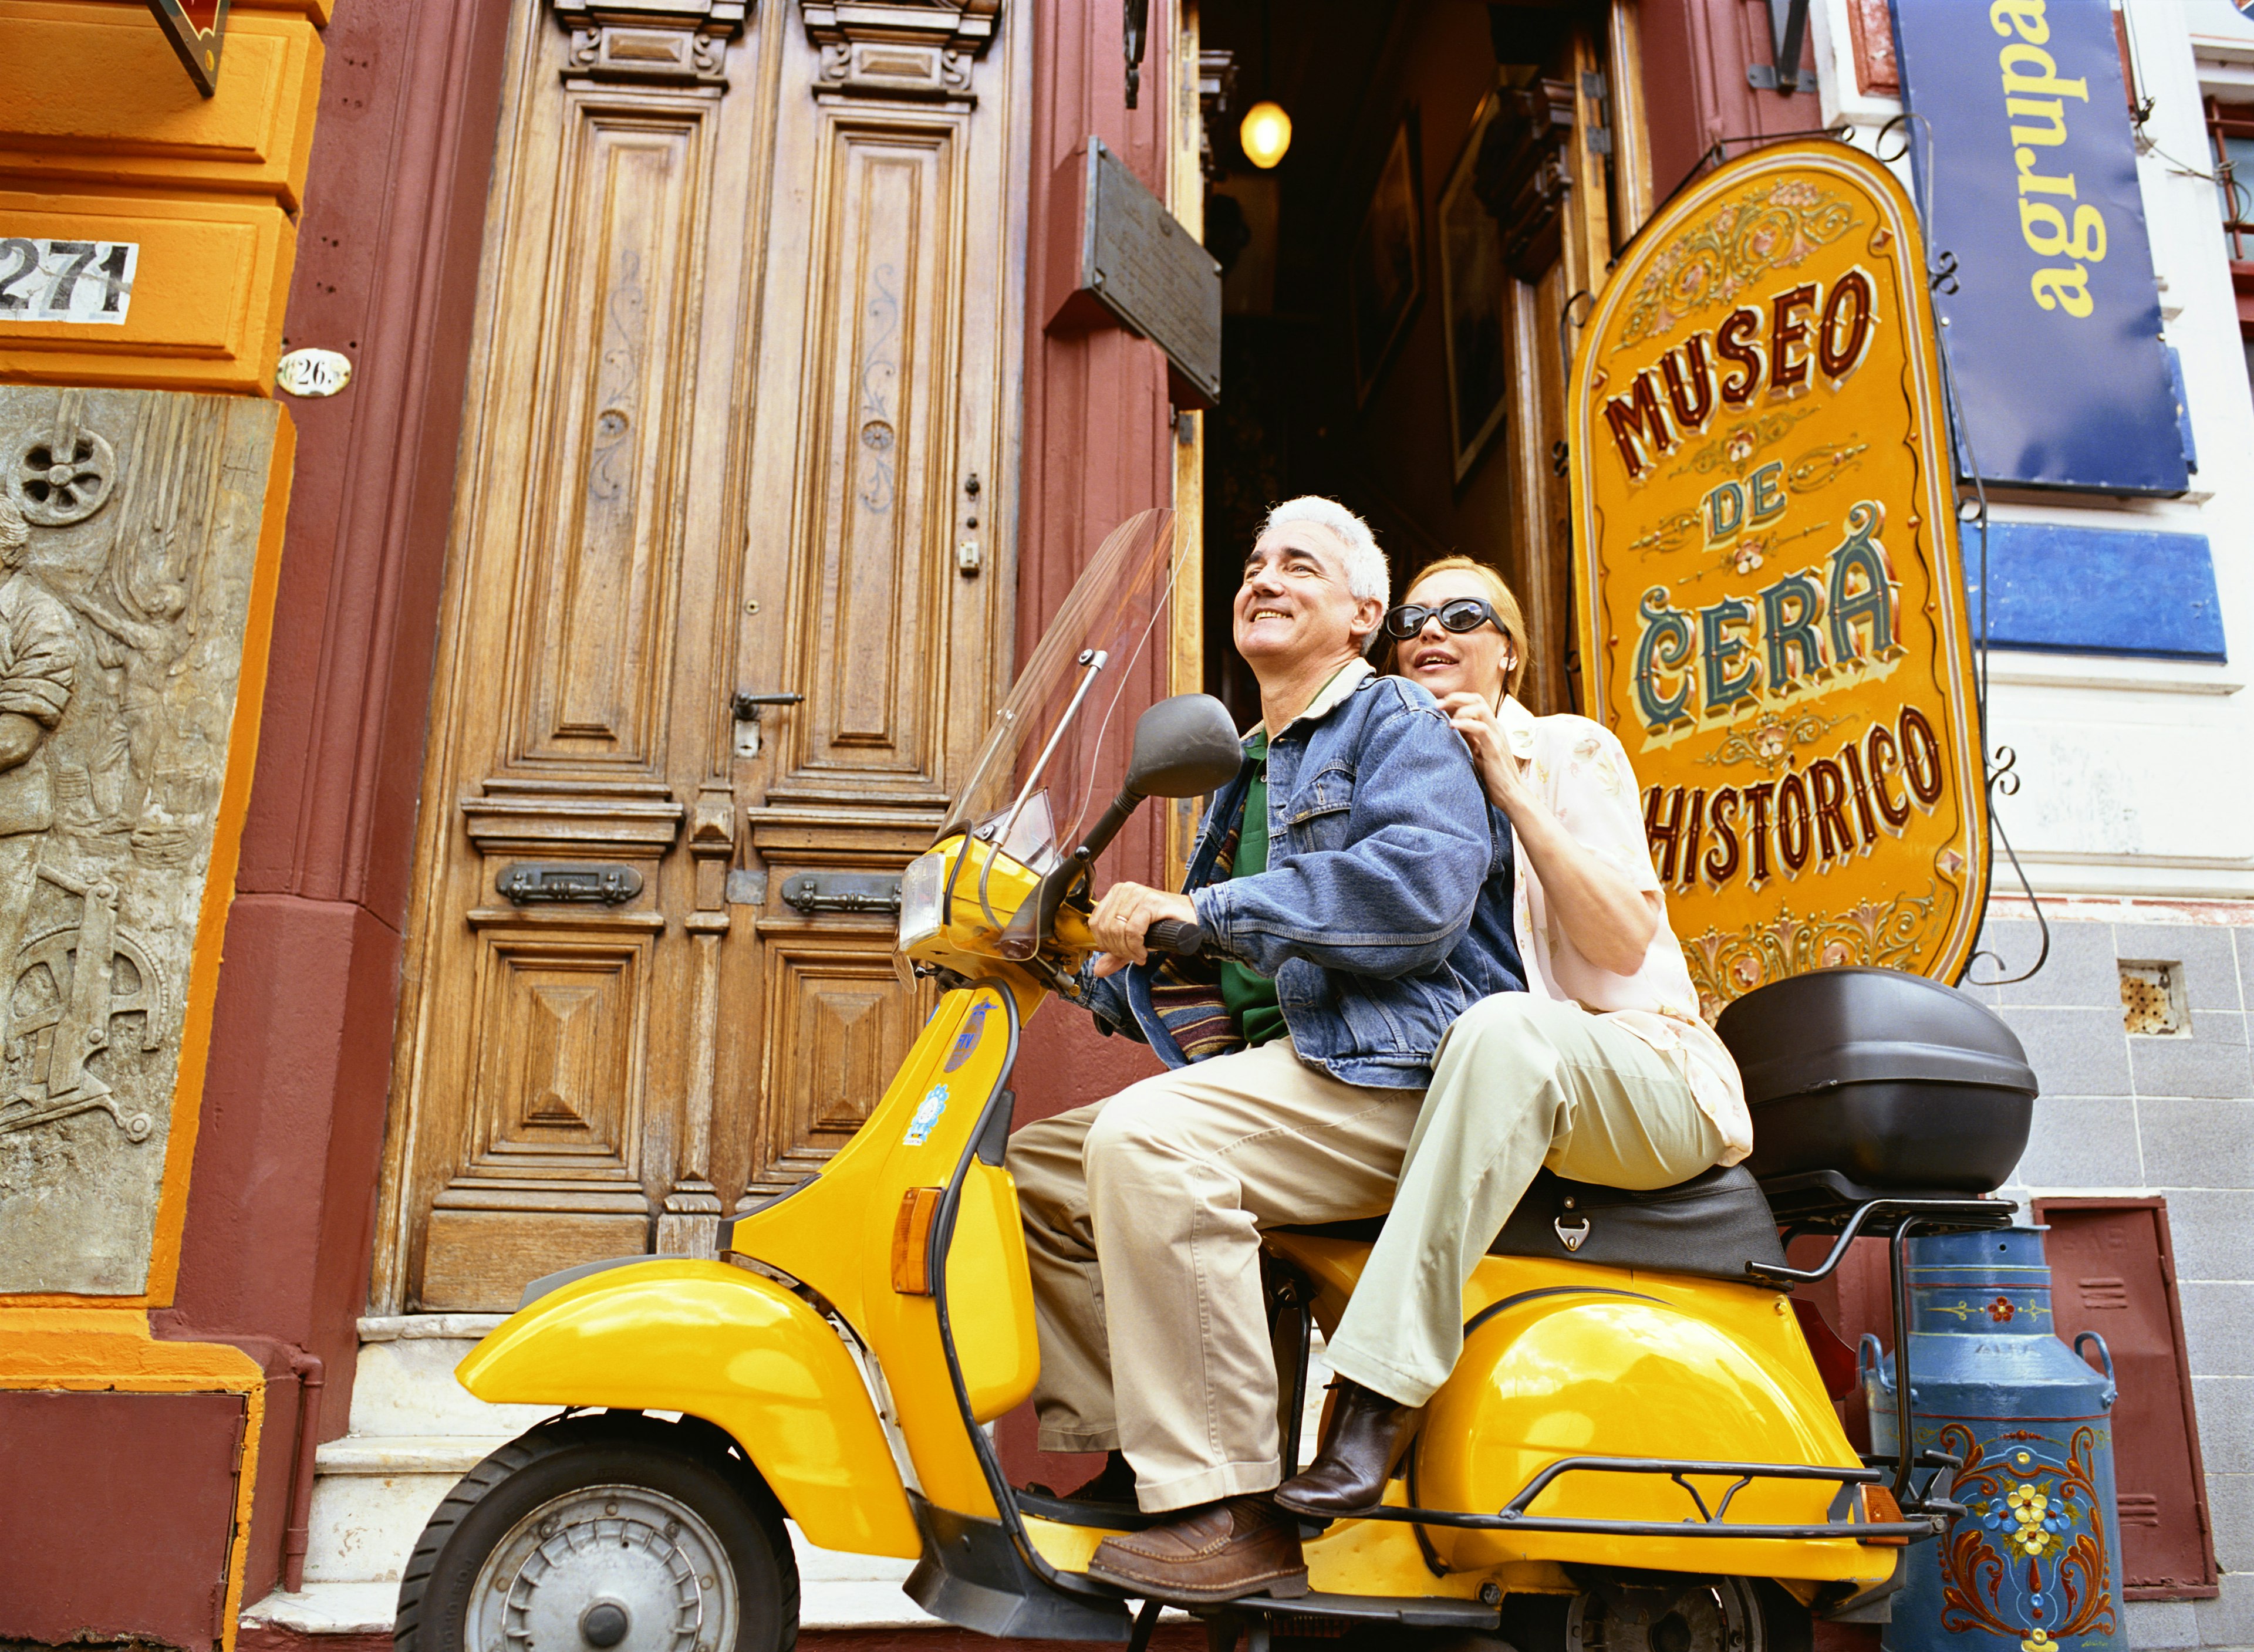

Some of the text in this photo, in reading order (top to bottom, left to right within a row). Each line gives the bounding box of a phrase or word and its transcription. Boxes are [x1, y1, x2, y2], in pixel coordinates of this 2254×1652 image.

[1989, 0, 2107, 318] agrupa
[1599, 264, 1881, 486] MUSEO
[1700, 461, 1783, 549] DE
[1631, 499, 1909, 748] CERA
[1642, 703, 1943, 896] HISTÓRICO
